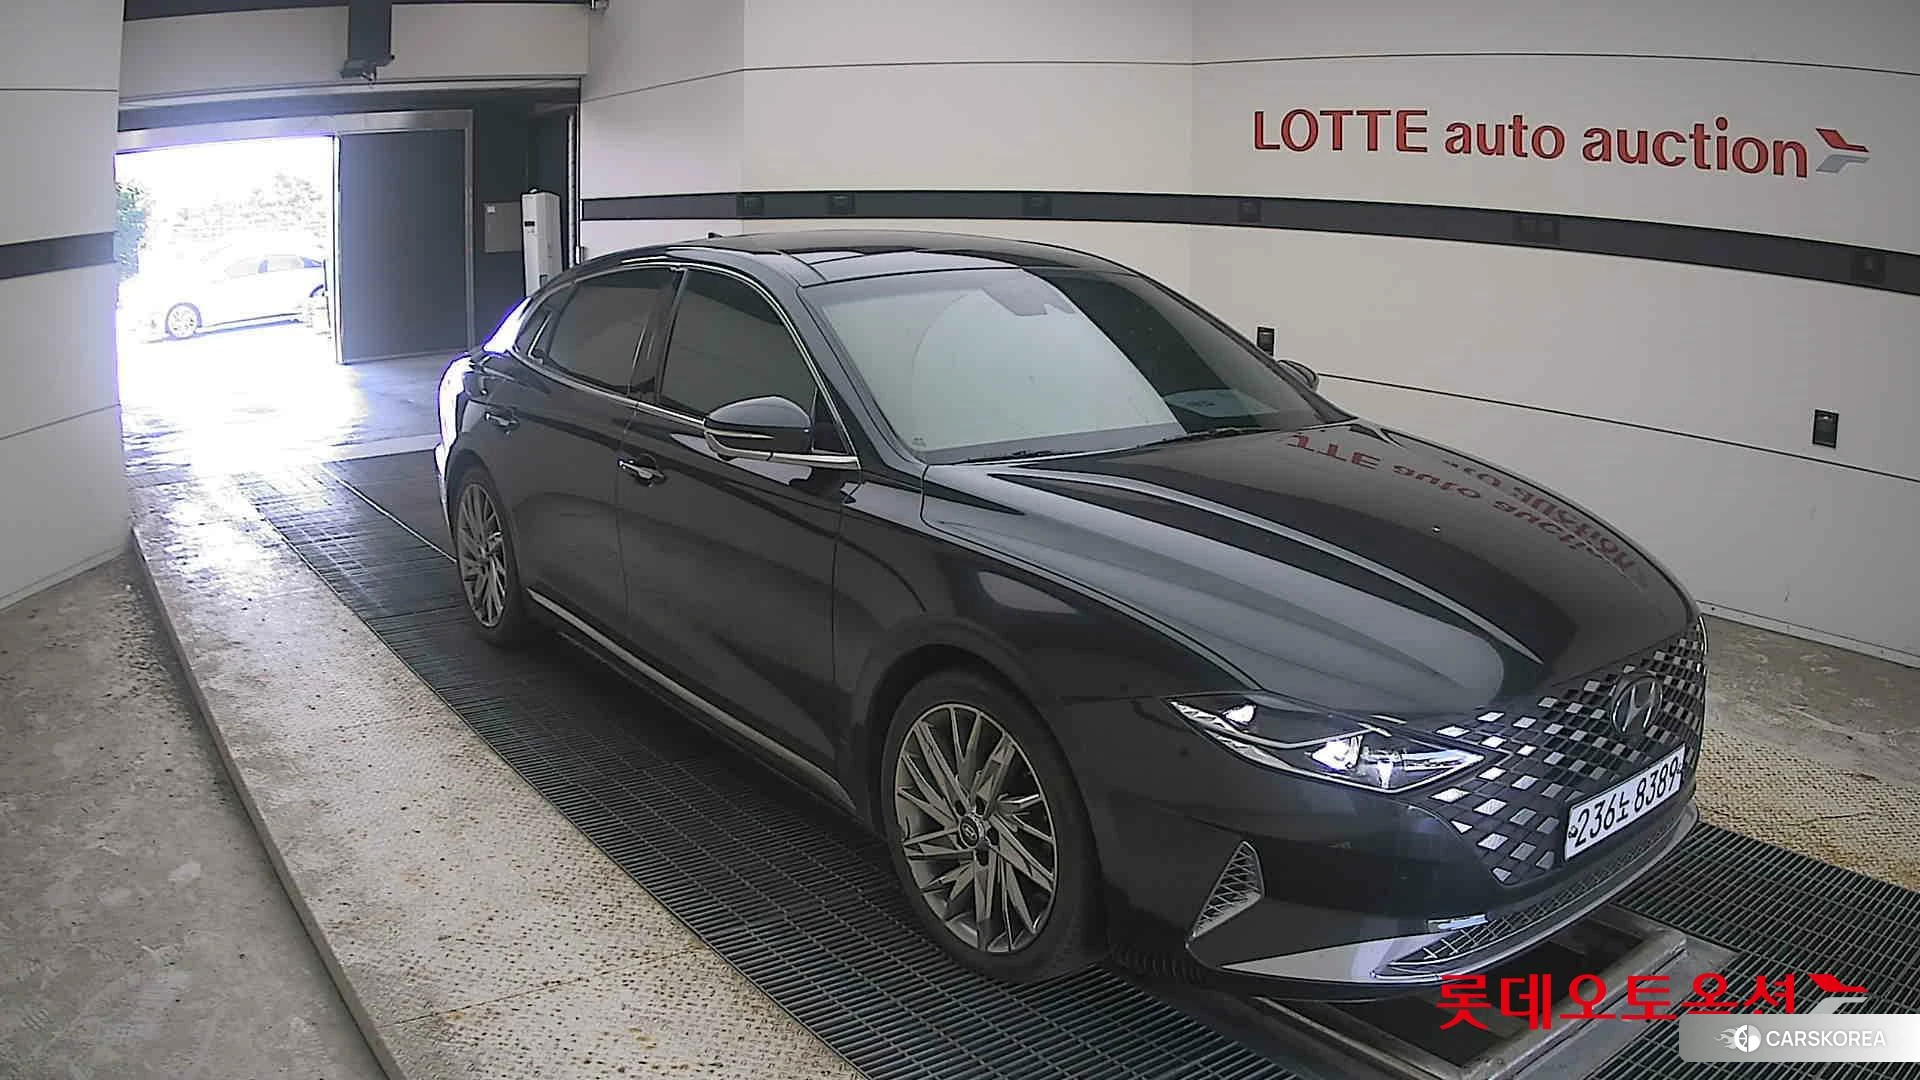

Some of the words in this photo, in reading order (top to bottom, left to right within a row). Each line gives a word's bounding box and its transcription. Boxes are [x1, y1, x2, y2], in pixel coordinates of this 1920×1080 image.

[1253, 109, 1428, 153] LOTTE
[1445, 114, 1566, 161] auto
[1582, 117, 1809, 179] auction
[1575, 791, 1629, 848] 236노
[1634, 756, 1680, 813] 8389
